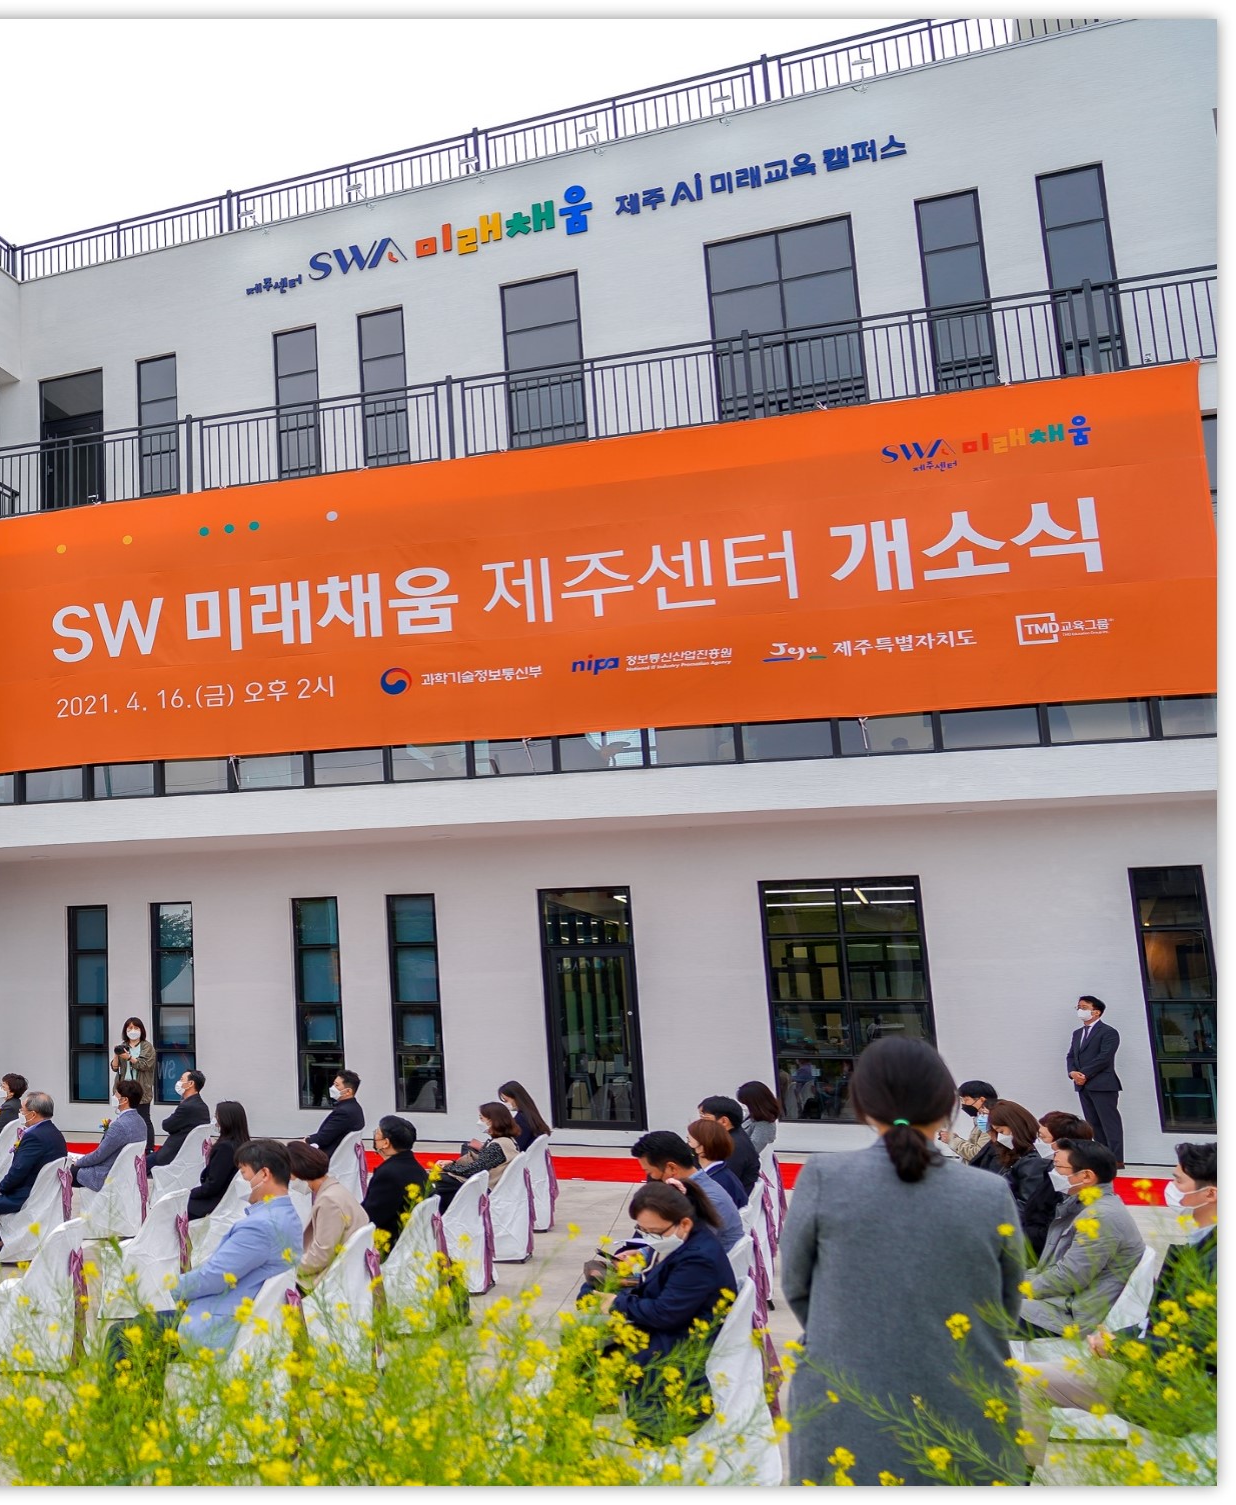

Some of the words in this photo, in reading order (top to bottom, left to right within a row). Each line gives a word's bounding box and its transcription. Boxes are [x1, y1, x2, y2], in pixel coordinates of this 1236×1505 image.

[246, 273, 302, 296] 제주센터
[415, 185, 593, 259] 미래채움
[615, 187, 666, 216] 제주
[710, 152, 817, 194] 미래교육
[822, 134, 907, 172] 캠퍼스
[962, 415, 1092, 454] 미래채움
[913, 460, 958, 473] 제주센터
[51, 597, 164, 664] SW
[185, 566, 459, 652] 미래채움
[481, 529, 801, 624] 제주센터
[830, 497, 1105, 593] 개소식
[1023, 622, 1060, 635] TMD
[1060, 618, 1110, 632] 교육그룹
[832, 629, 978, 657] 제주특별자치도
[571, 654, 620, 675] nipa
[625, 647, 733, 666] 정보통신산업진흥원
[421, 665, 543, 687] 과학기술정보통신부
[56, 693, 119, 719] 2021.
[126, 691, 148, 712] 4.
[157, 683, 235, 710] 16.(금)
[244, 679, 289, 704] 오후
[296, 675, 335, 700] 2시
